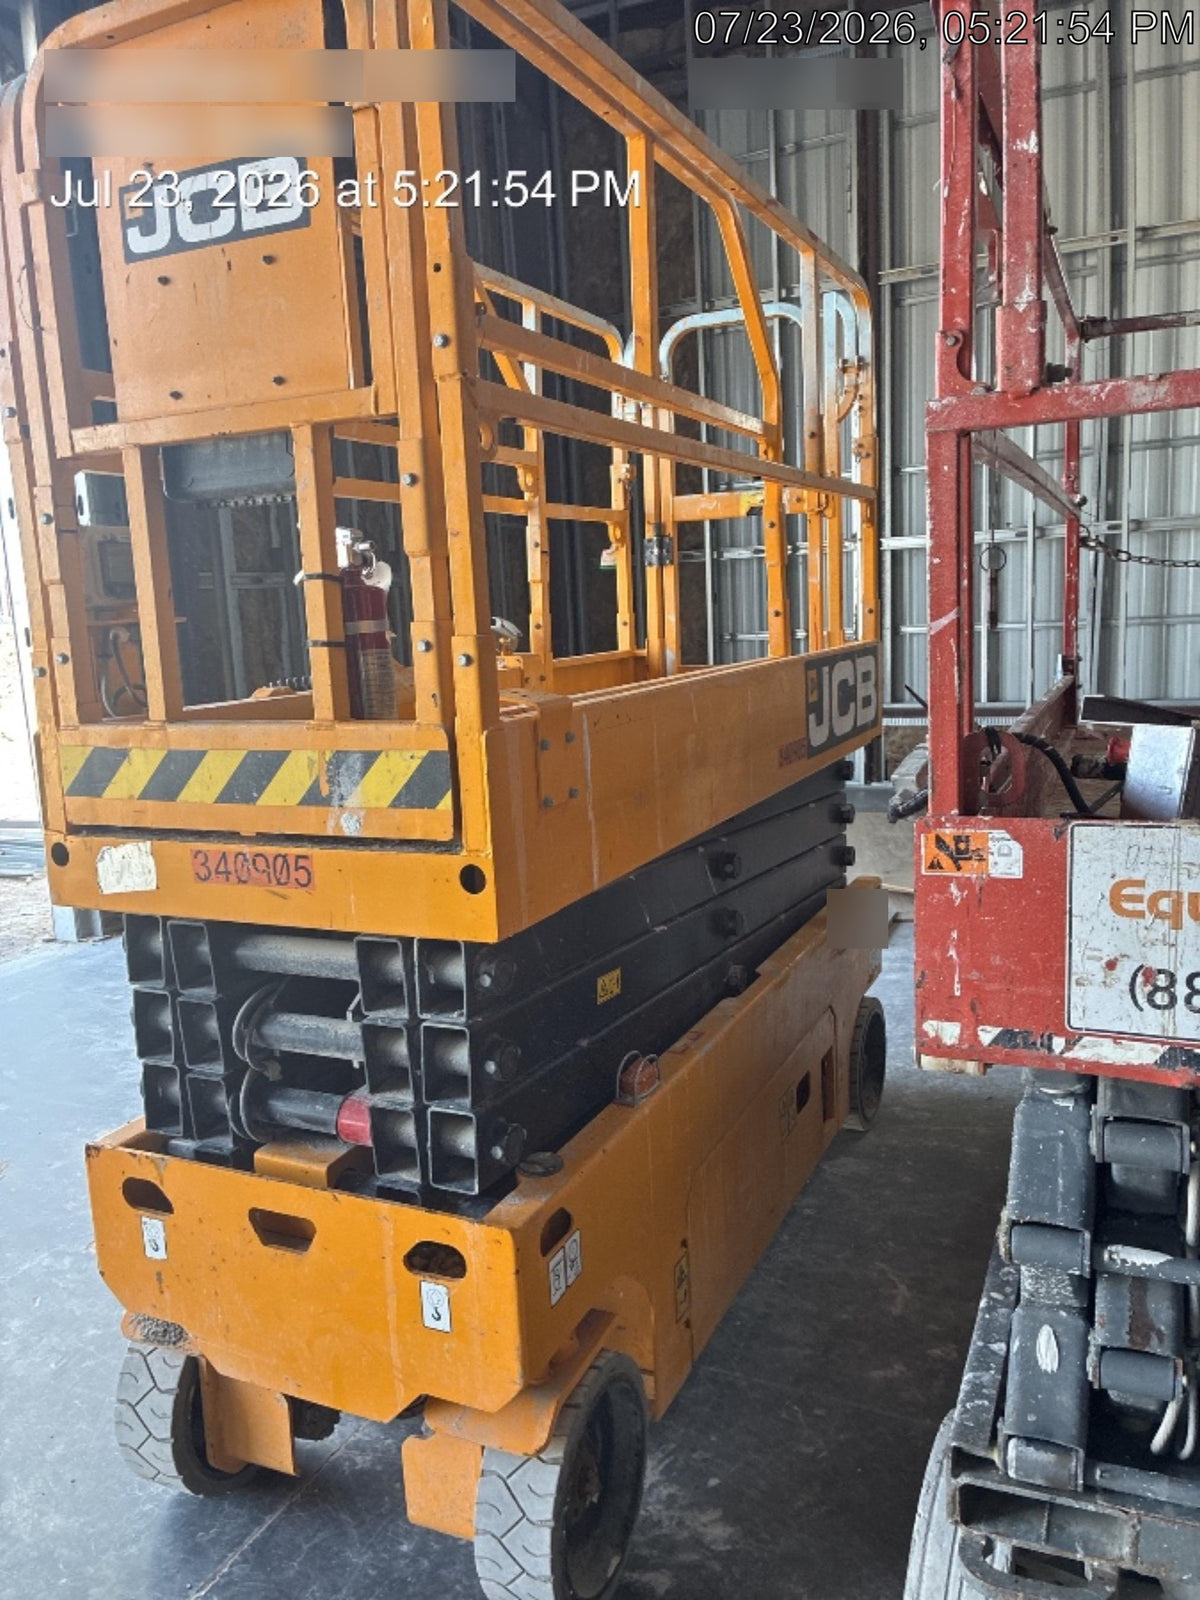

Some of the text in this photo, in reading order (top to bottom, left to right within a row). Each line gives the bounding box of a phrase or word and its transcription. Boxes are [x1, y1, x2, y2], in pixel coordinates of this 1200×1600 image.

[124, 156, 304, 254] JCB
[807, 655, 877, 748] JCB
[193, 850, 312, 887] 340905
